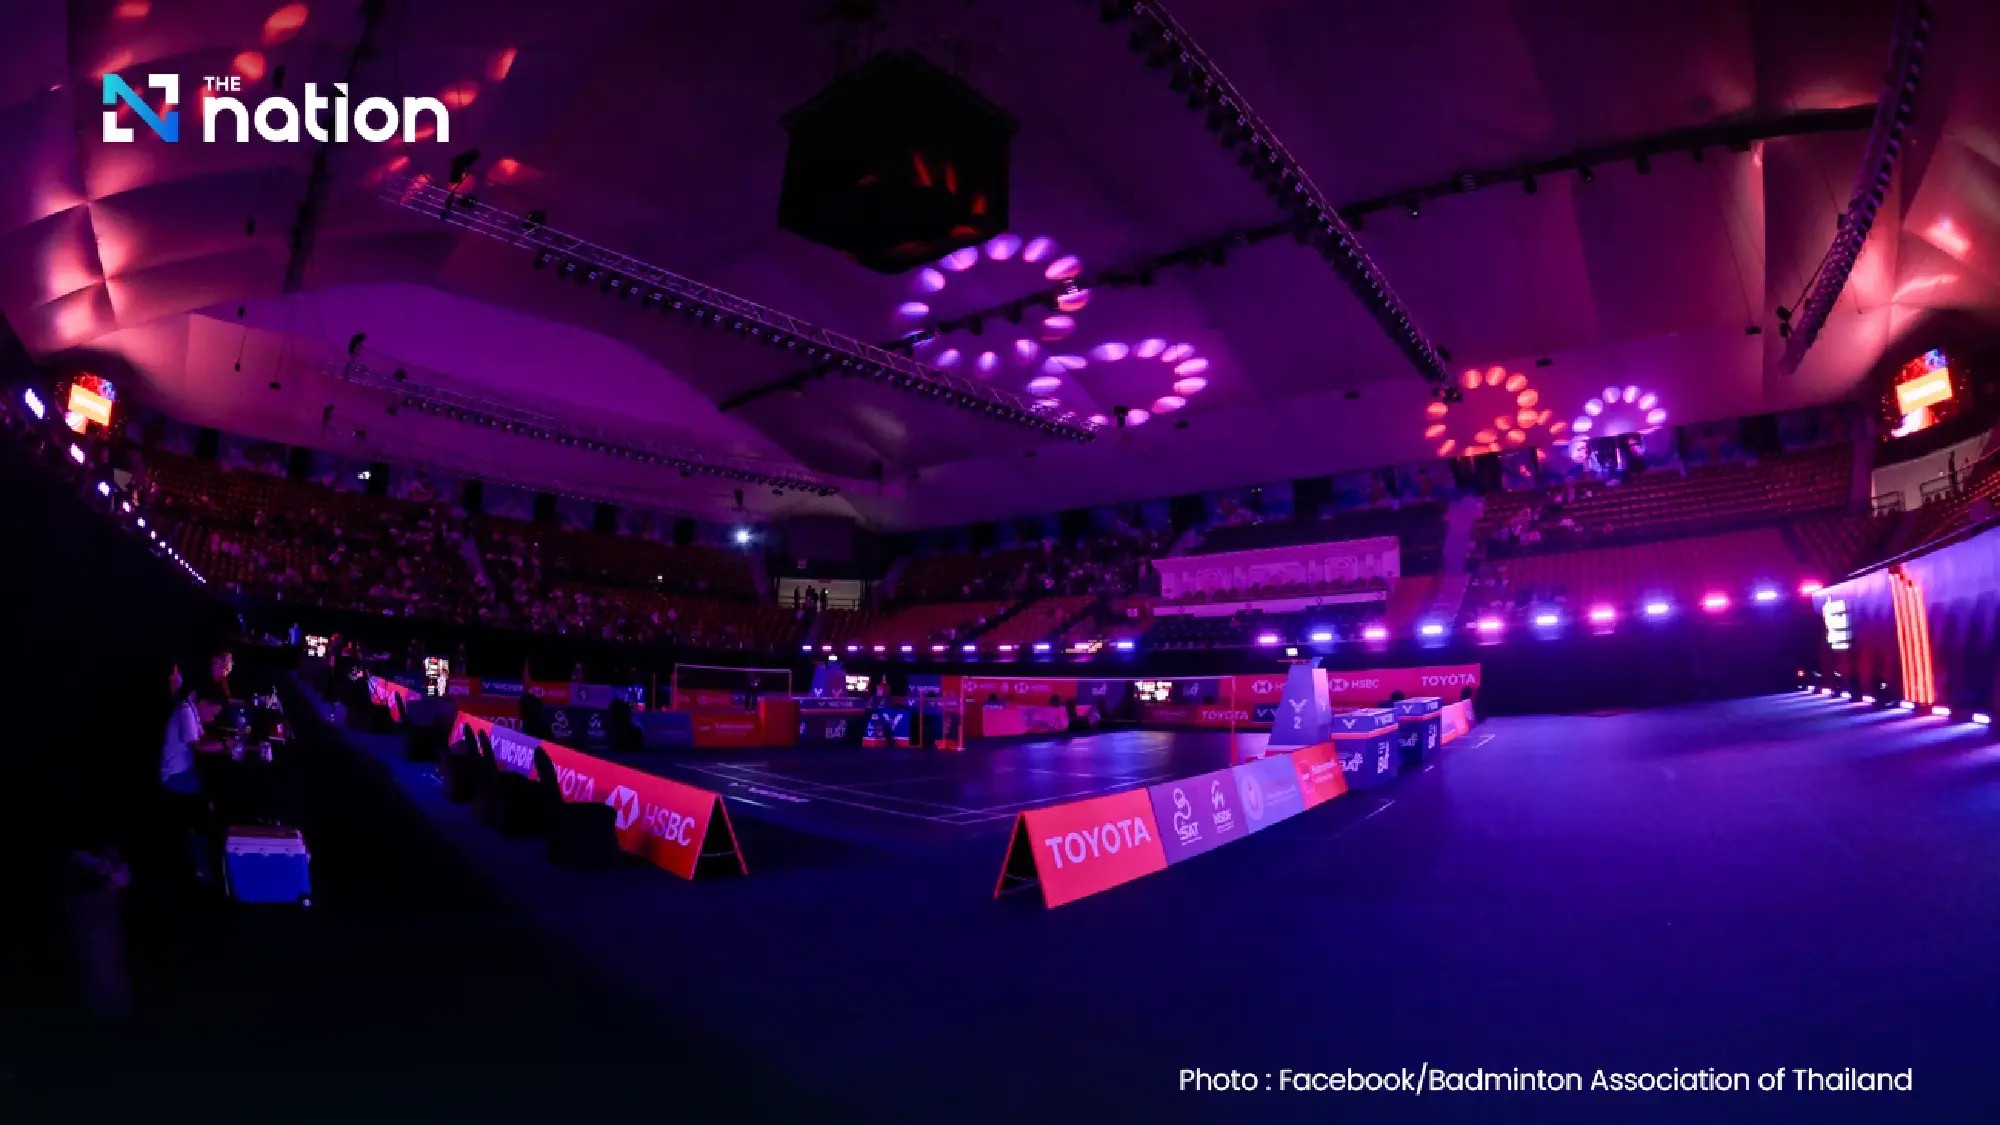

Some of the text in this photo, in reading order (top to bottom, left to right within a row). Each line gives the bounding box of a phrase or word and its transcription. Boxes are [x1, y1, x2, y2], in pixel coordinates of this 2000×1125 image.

[1351, 678, 1380, 689] HSBC
[1421, 673, 1476, 687] TOYOTA
[1201, 709, 1249, 721] TOYOTA
[1293, 716, 1302, 729] 2
[552, 761, 695, 847] YOTA HSBC
[1044, 816, 1152, 868] TOYOTA
